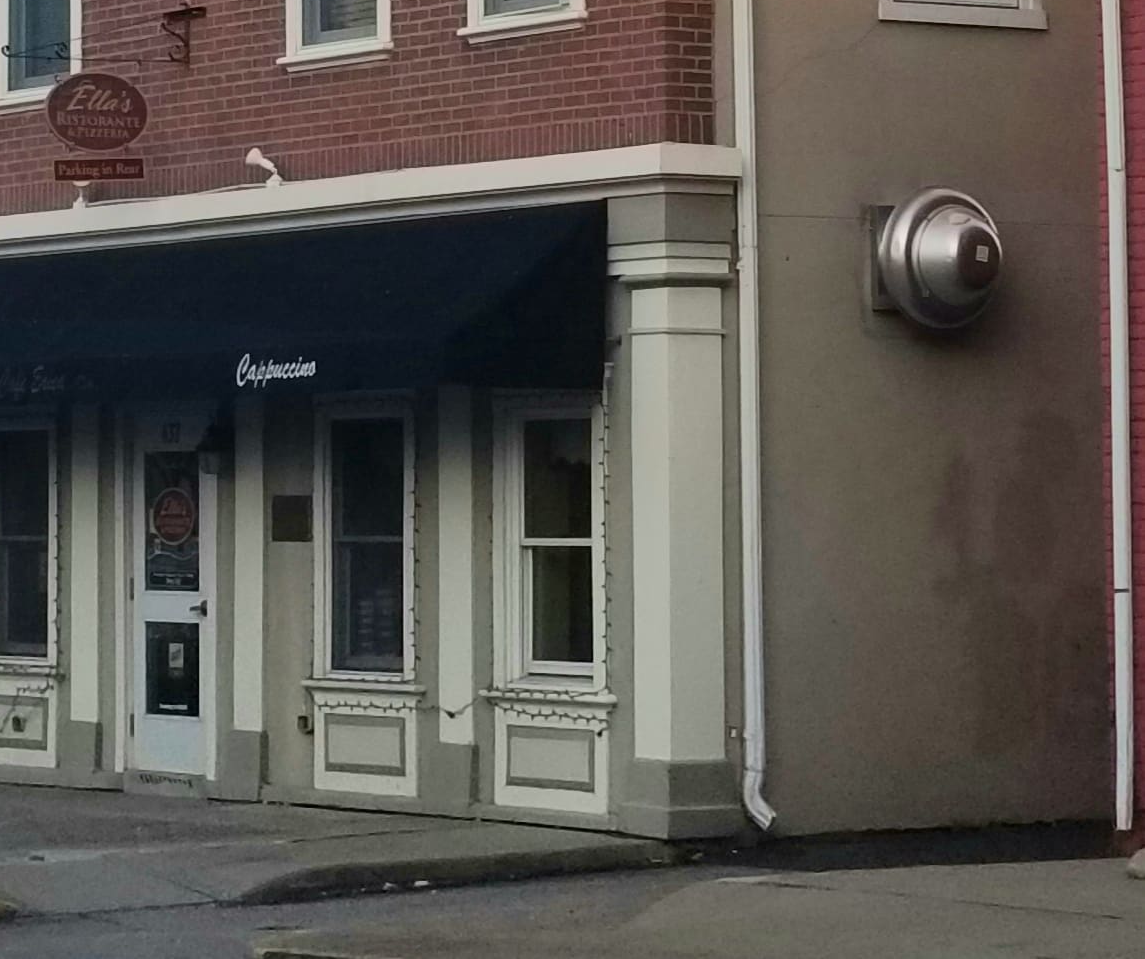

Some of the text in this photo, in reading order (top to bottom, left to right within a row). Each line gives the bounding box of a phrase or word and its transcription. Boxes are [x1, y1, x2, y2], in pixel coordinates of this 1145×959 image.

[67, 84, 132, 113] Ella's
[56, 112, 141, 128] RISTORANTE
[58, 162, 140, 178] Parking in Rear
[236, 353, 316, 388] Cappuccino
